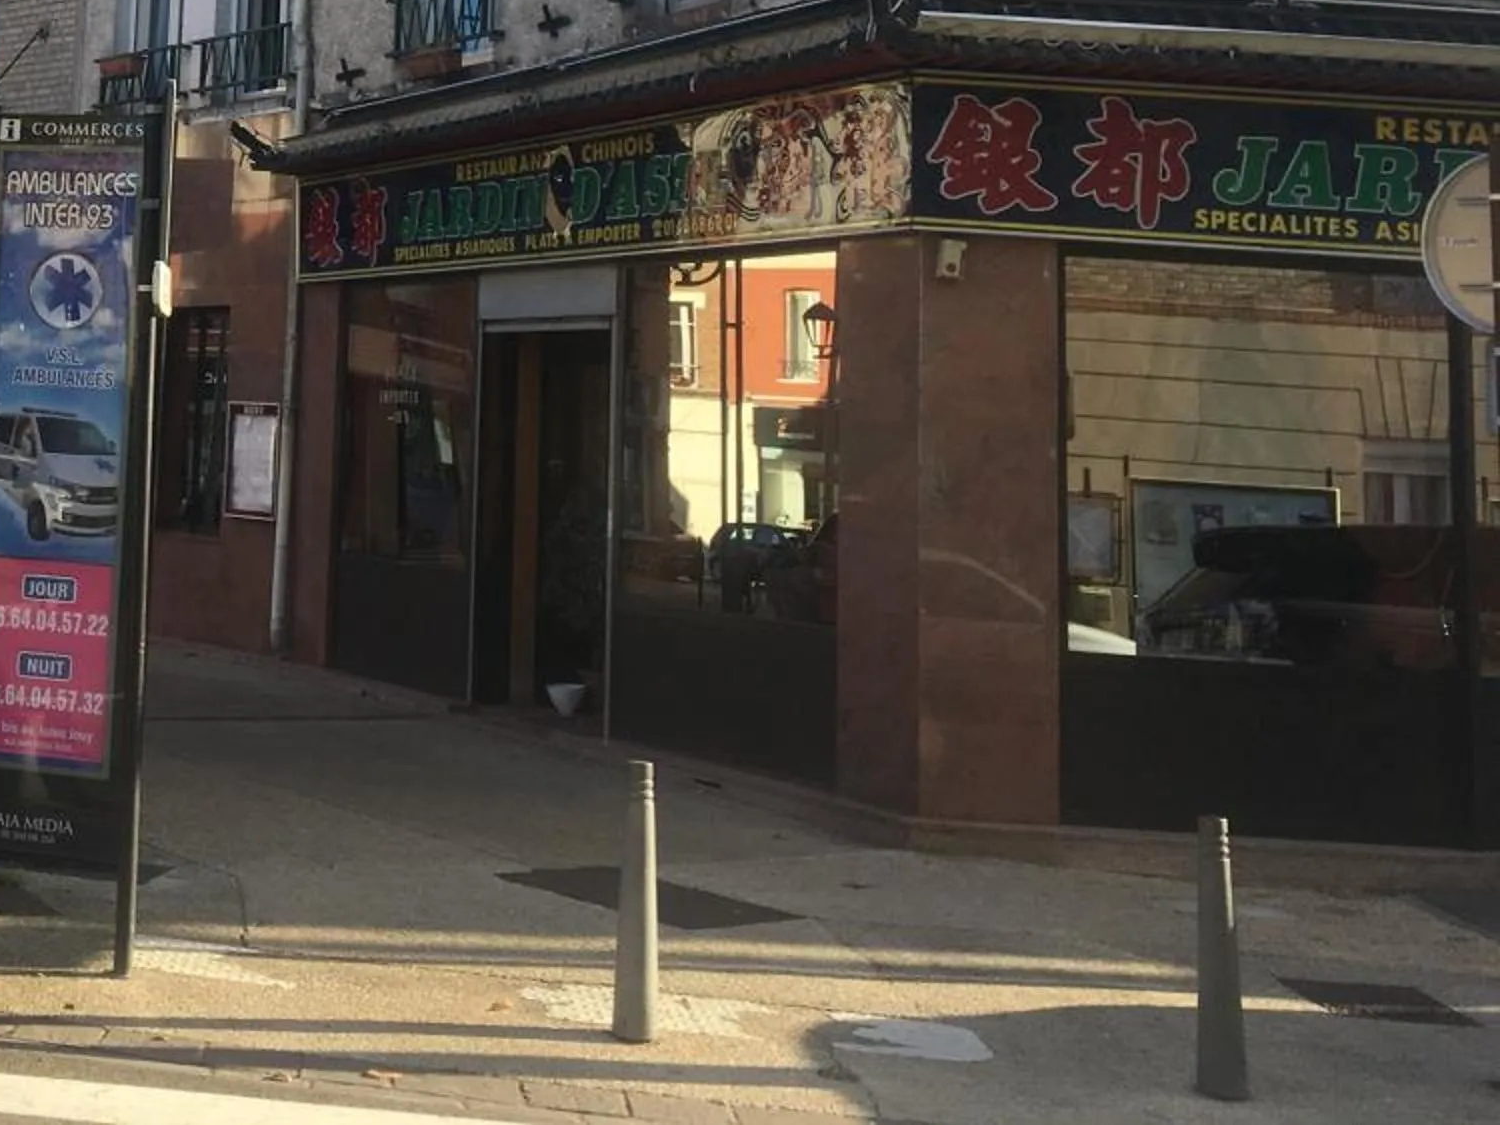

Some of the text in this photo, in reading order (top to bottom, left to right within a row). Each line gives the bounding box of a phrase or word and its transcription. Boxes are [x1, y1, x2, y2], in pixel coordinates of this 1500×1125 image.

[32, 122, 145, 137] COMMERCES
[1375, 115, 1490, 145] RESTA
[582, 133, 655, 163] CHINOIS
[7, 170, 139, 197] AMBULANCES
[1213, 135, 1489, 217] JAR
[25, 202, 113, 229] INTER 93
[401, 172, 548, 243] JARDIN
[1195, 208, 1358, 240] SPECIALITES
[1376, 220, 1419, 242] ASI
[455, 236, 515, 256] ASIATIQUES
[578, 223, 641, 245] EMPORTER
[11, 366, 117, 391] AMBULANCES
[28, 580, 69, 599] JOUR
[27, 658, 66, 676] NUIT
